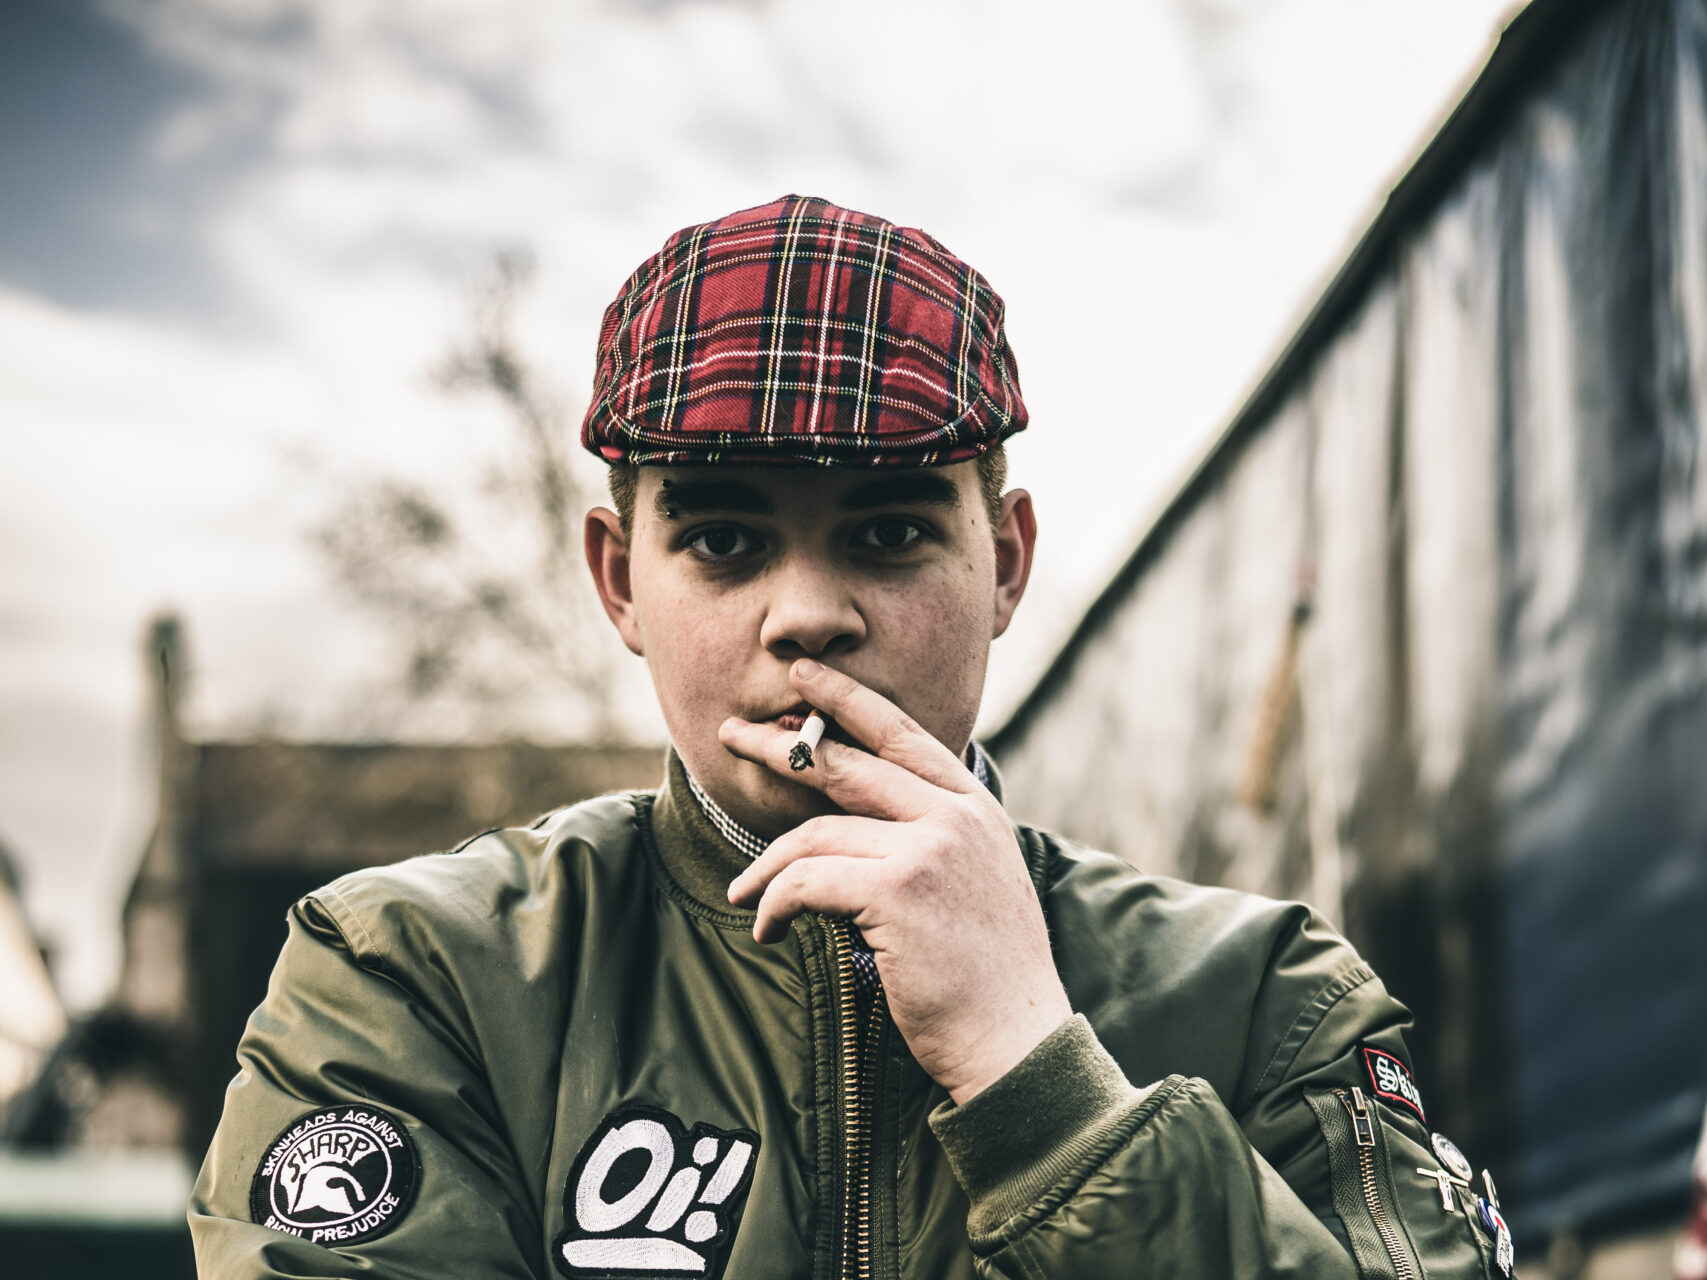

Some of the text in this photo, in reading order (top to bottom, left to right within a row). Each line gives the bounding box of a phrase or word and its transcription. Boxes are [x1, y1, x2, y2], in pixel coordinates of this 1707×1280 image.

[261, 1109, 404, 1177] SKINHEADS AGAINST
[287, 1132, 371, 1184] SHARP
[575, 1118, 753, 1243] Oi!
[311, 1192, 401, 1243] PREJUDICE
